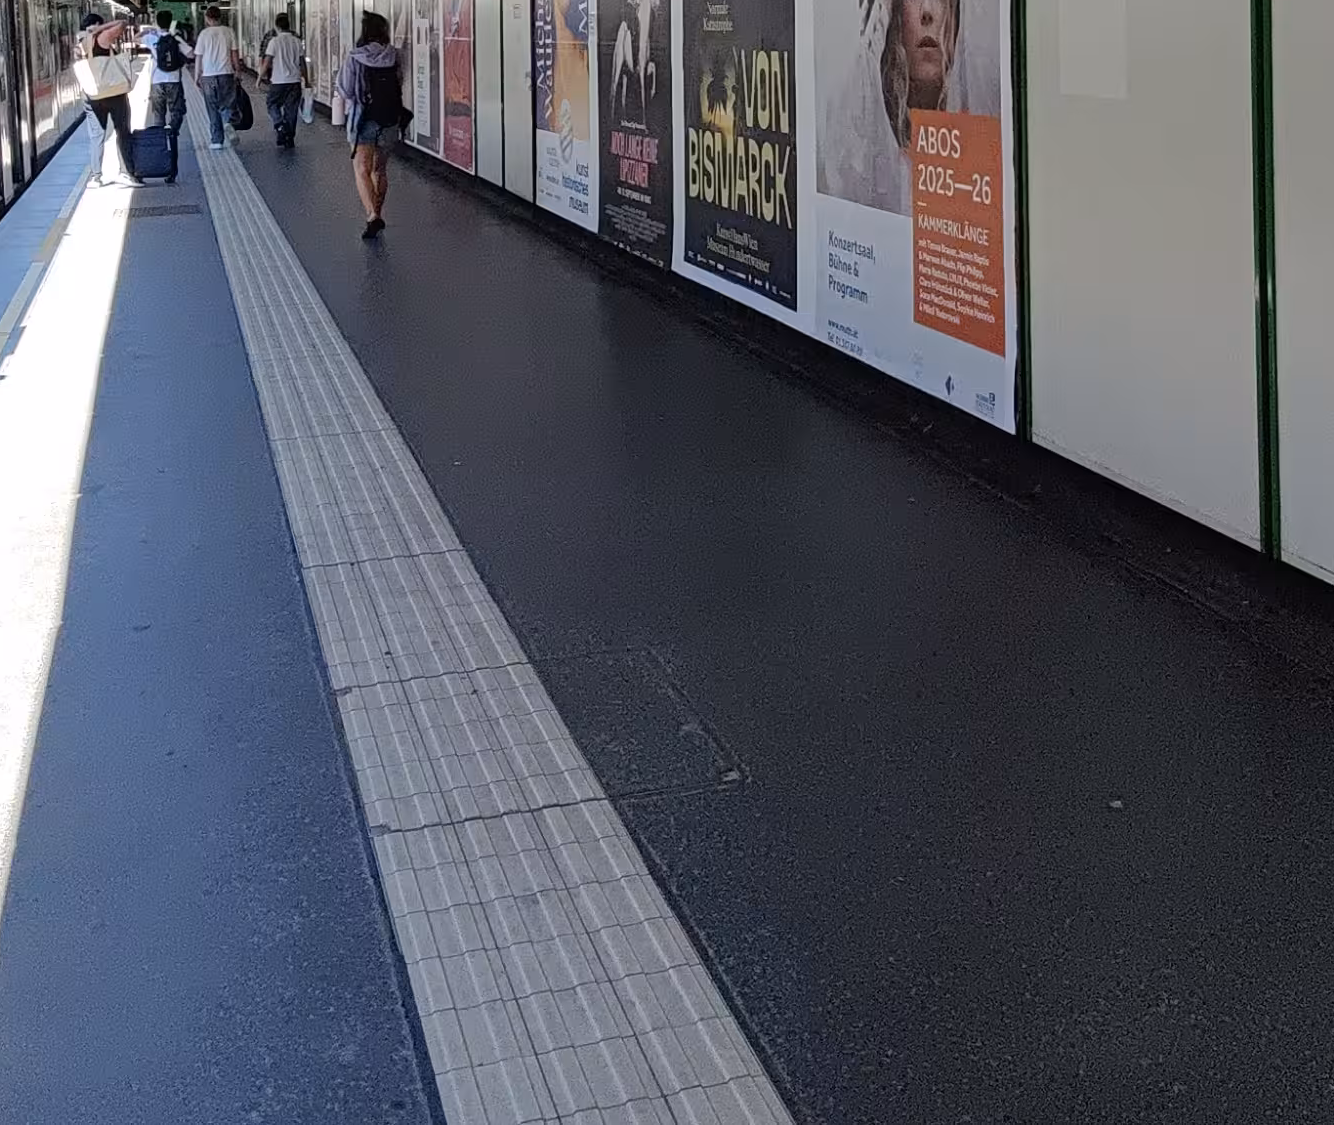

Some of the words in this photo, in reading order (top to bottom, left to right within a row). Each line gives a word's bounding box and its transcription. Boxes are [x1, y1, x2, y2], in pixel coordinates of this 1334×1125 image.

[741, 49, 790, 134] VON
[916, 124, 961, 159] ABOS
[687, 126, 793, 230] BISMARCK
[917, 212, 990, 246] KAMMERKLÄNGE
[828, 230, 876, 264] Konzertsaal,
[828, 252, 853, 276] Bühne
[853, 261, 860, 278] &
[828, 274, 868, 304] Programm
